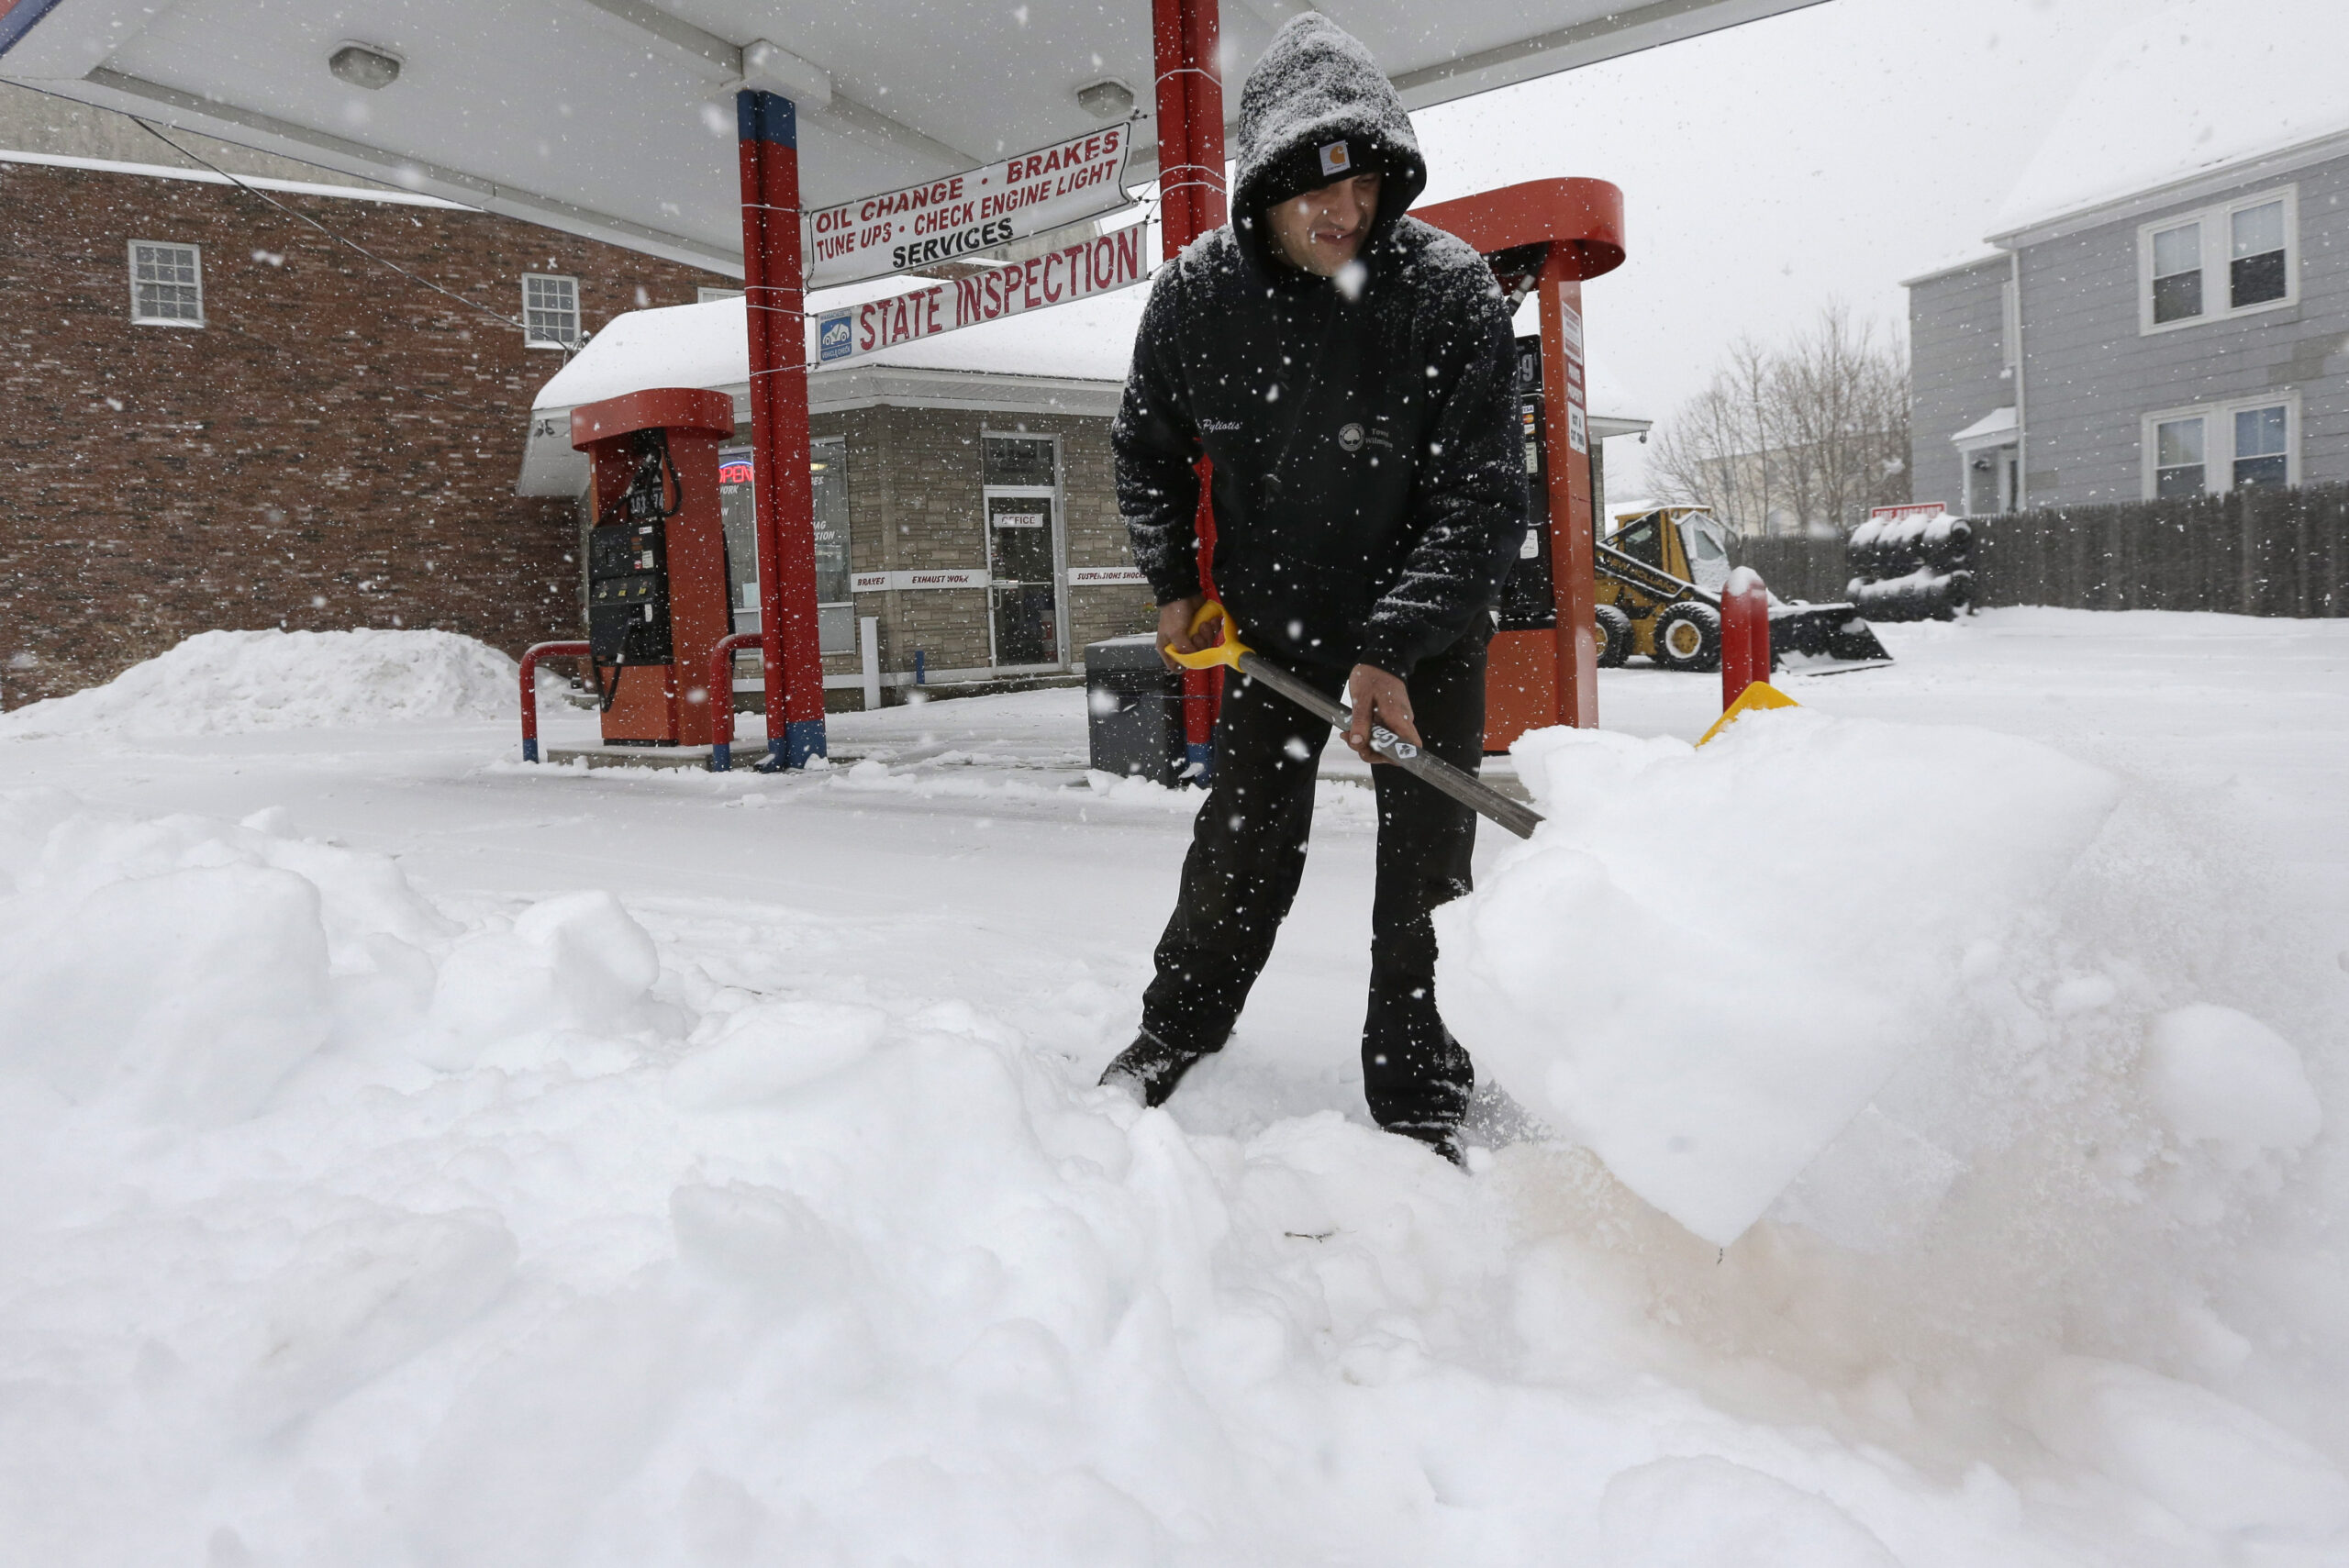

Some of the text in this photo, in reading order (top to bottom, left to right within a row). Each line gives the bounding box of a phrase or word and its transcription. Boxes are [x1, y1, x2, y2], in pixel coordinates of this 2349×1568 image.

[816, 130, 1119, 234] OIL CHANGE BRAKES
[816, 158, 1118, 262] TUNE UPS CHECK ENGINE LIGHT
[893, 217, 1014, 269] SERVICES
[859, 227, 1139, 351] STATE INSPECTION
[857, 577, 885, 586] BRAKES
[912, 575, 946, 584] EXHAUST
